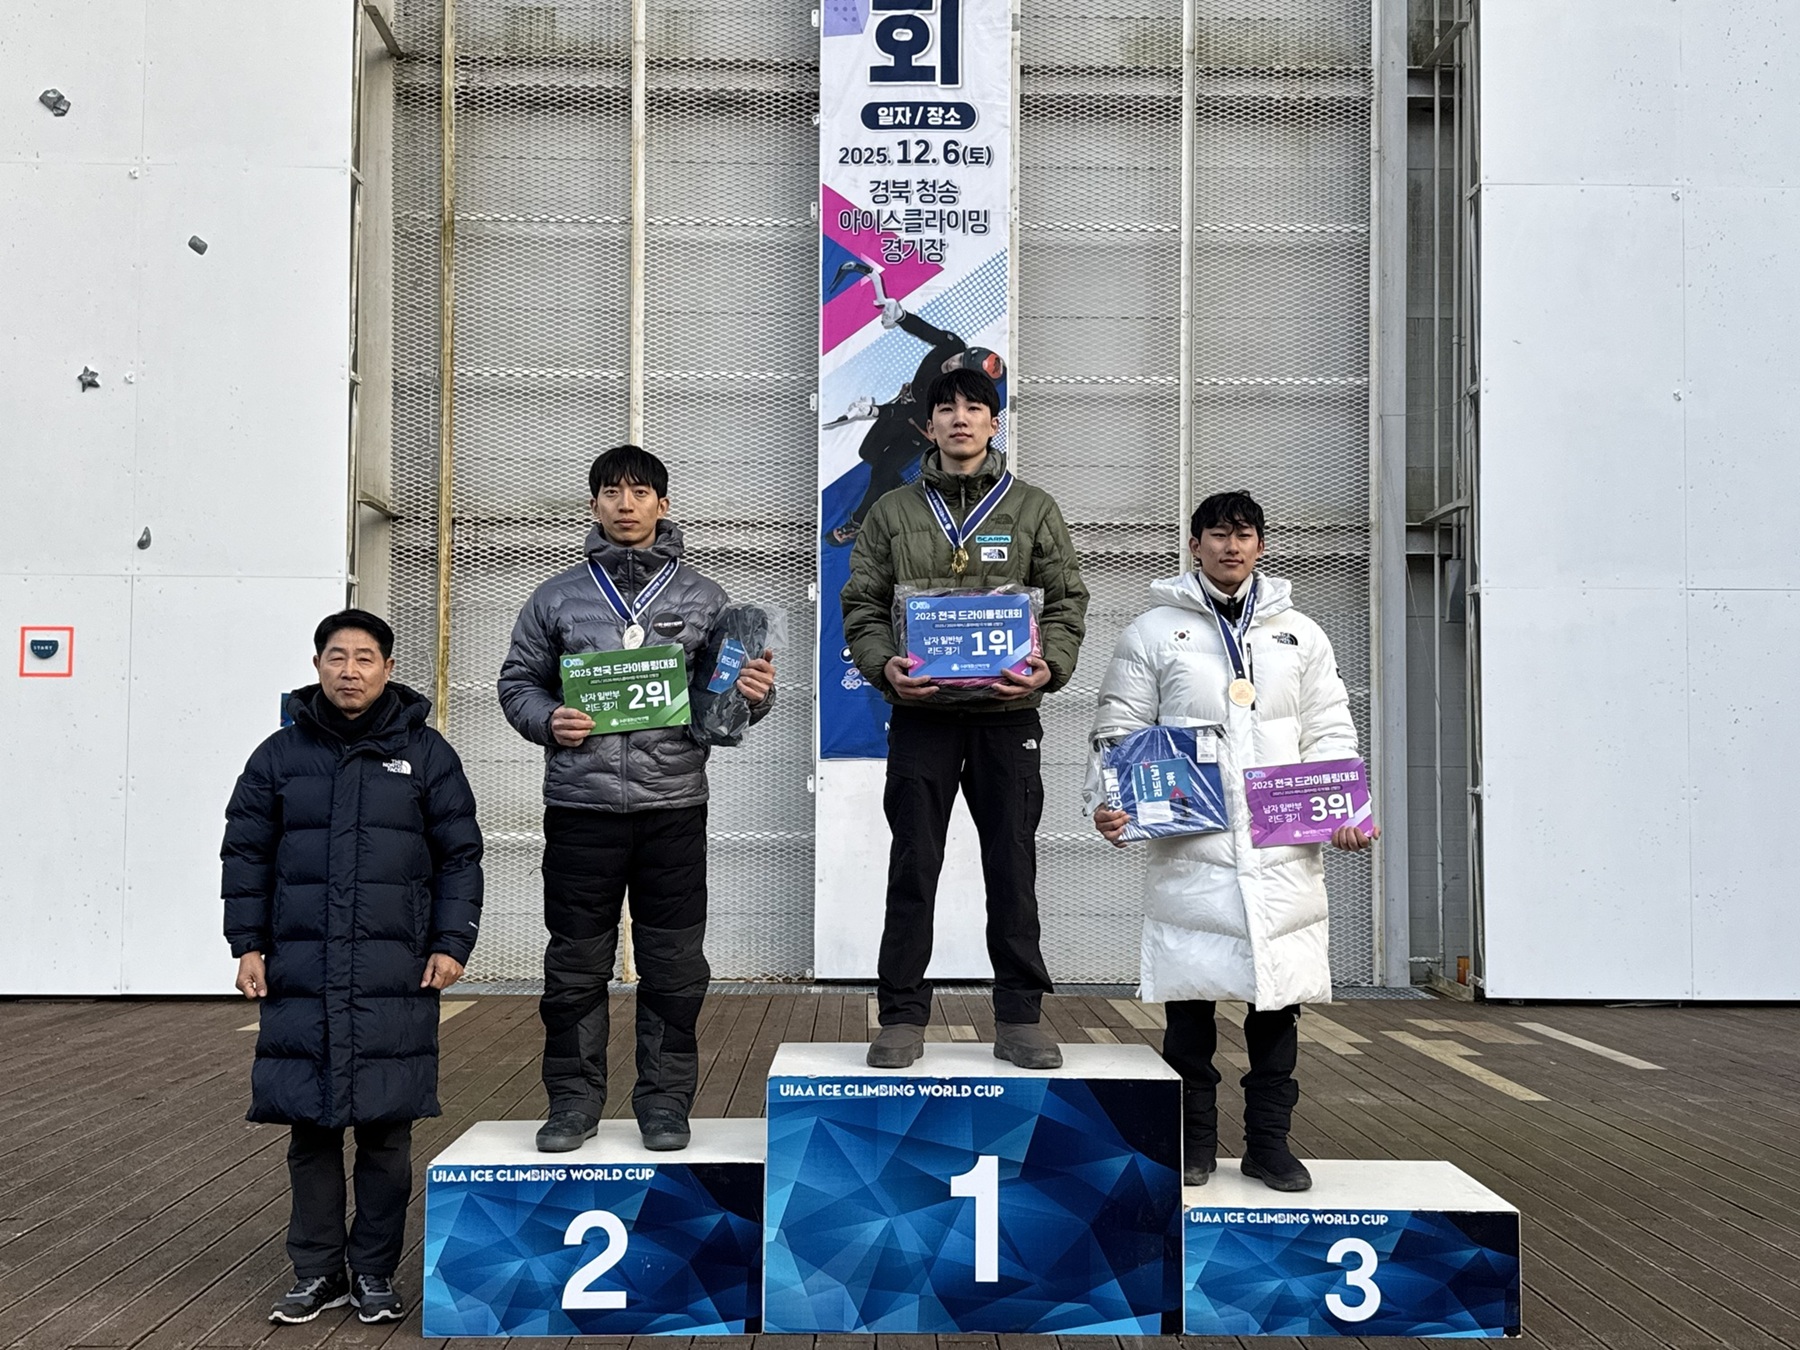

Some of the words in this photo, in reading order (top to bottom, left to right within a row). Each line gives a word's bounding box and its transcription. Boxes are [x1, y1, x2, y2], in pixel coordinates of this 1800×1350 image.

[869, 179, 911, 204] 경북
[916, 179, 959, 204] 청송
[839, 209, 989, 234] 아이스클라이밍
[881, 238, 946, 263] 경기장
[915, 612, 937, 621] 2025
[938, 610, 957, 621] 전국
[923, 636, 939, 646] 남자
[940, 636, 963, 646] 일반부
[971, 629, 1014, 657] 1위
[927, 647, 944, 656] 리드
[944, 646, 960, 656] 경기
[569, 669, 591, 678] 2025
[592, 665, 612, 677] 전국
[613, 658, 678, 675] 드라이툴링대회
[580, 690, 596, 703] 남자
[597, 690, 621, 701] 일반부
[627, 680, 672, 710] 2위
[585, 702, 601, 712] 리드
[602, 701, 618, 711] 경기
[1252, 780, 1273, 790] 2025
[1275, 778, 1293, 788] 전국
[1263, 804, 1279, 814] 남자
[1280, 802, 1303, 813] 일반부
[1309, 793, 1355, 822] 3위
[1268, 814, 1284, 824] 리드
[1285, 813, 1301, 823] 경기
[779, 1084, 815, 1097] UIAA
[818, 1085, 841, 1097] ICE
[844, 1085, 915, 1098] CLIMBING
[918, 1085, 971, 1098] WORLD
[974, 1085, 1005, 1098] CUP
[432, 1170, 467, 1182] UIAA
[470, 1170, 493, 1182] ICE
[496, 1169, 567, 1182] CLIMBING
[570, 1168, 622, 1181] WORLD
[625, 1168, 655, 1181] CUP
[950, 1155, 999, 1282] 1
[1190, 1211, 1222, 1223] UIAA
[1224, 1212, 1245, 1224] ICE
[1247, 1212, 1310, 1225] CLIMBING
[1311, 1213, 1359, 1226] WORLD
[1361, 1213, 1389, 1226] CUP
[561, 1210, 629, 1309] 2
[1325, 1237, 1381, 1322] 3
